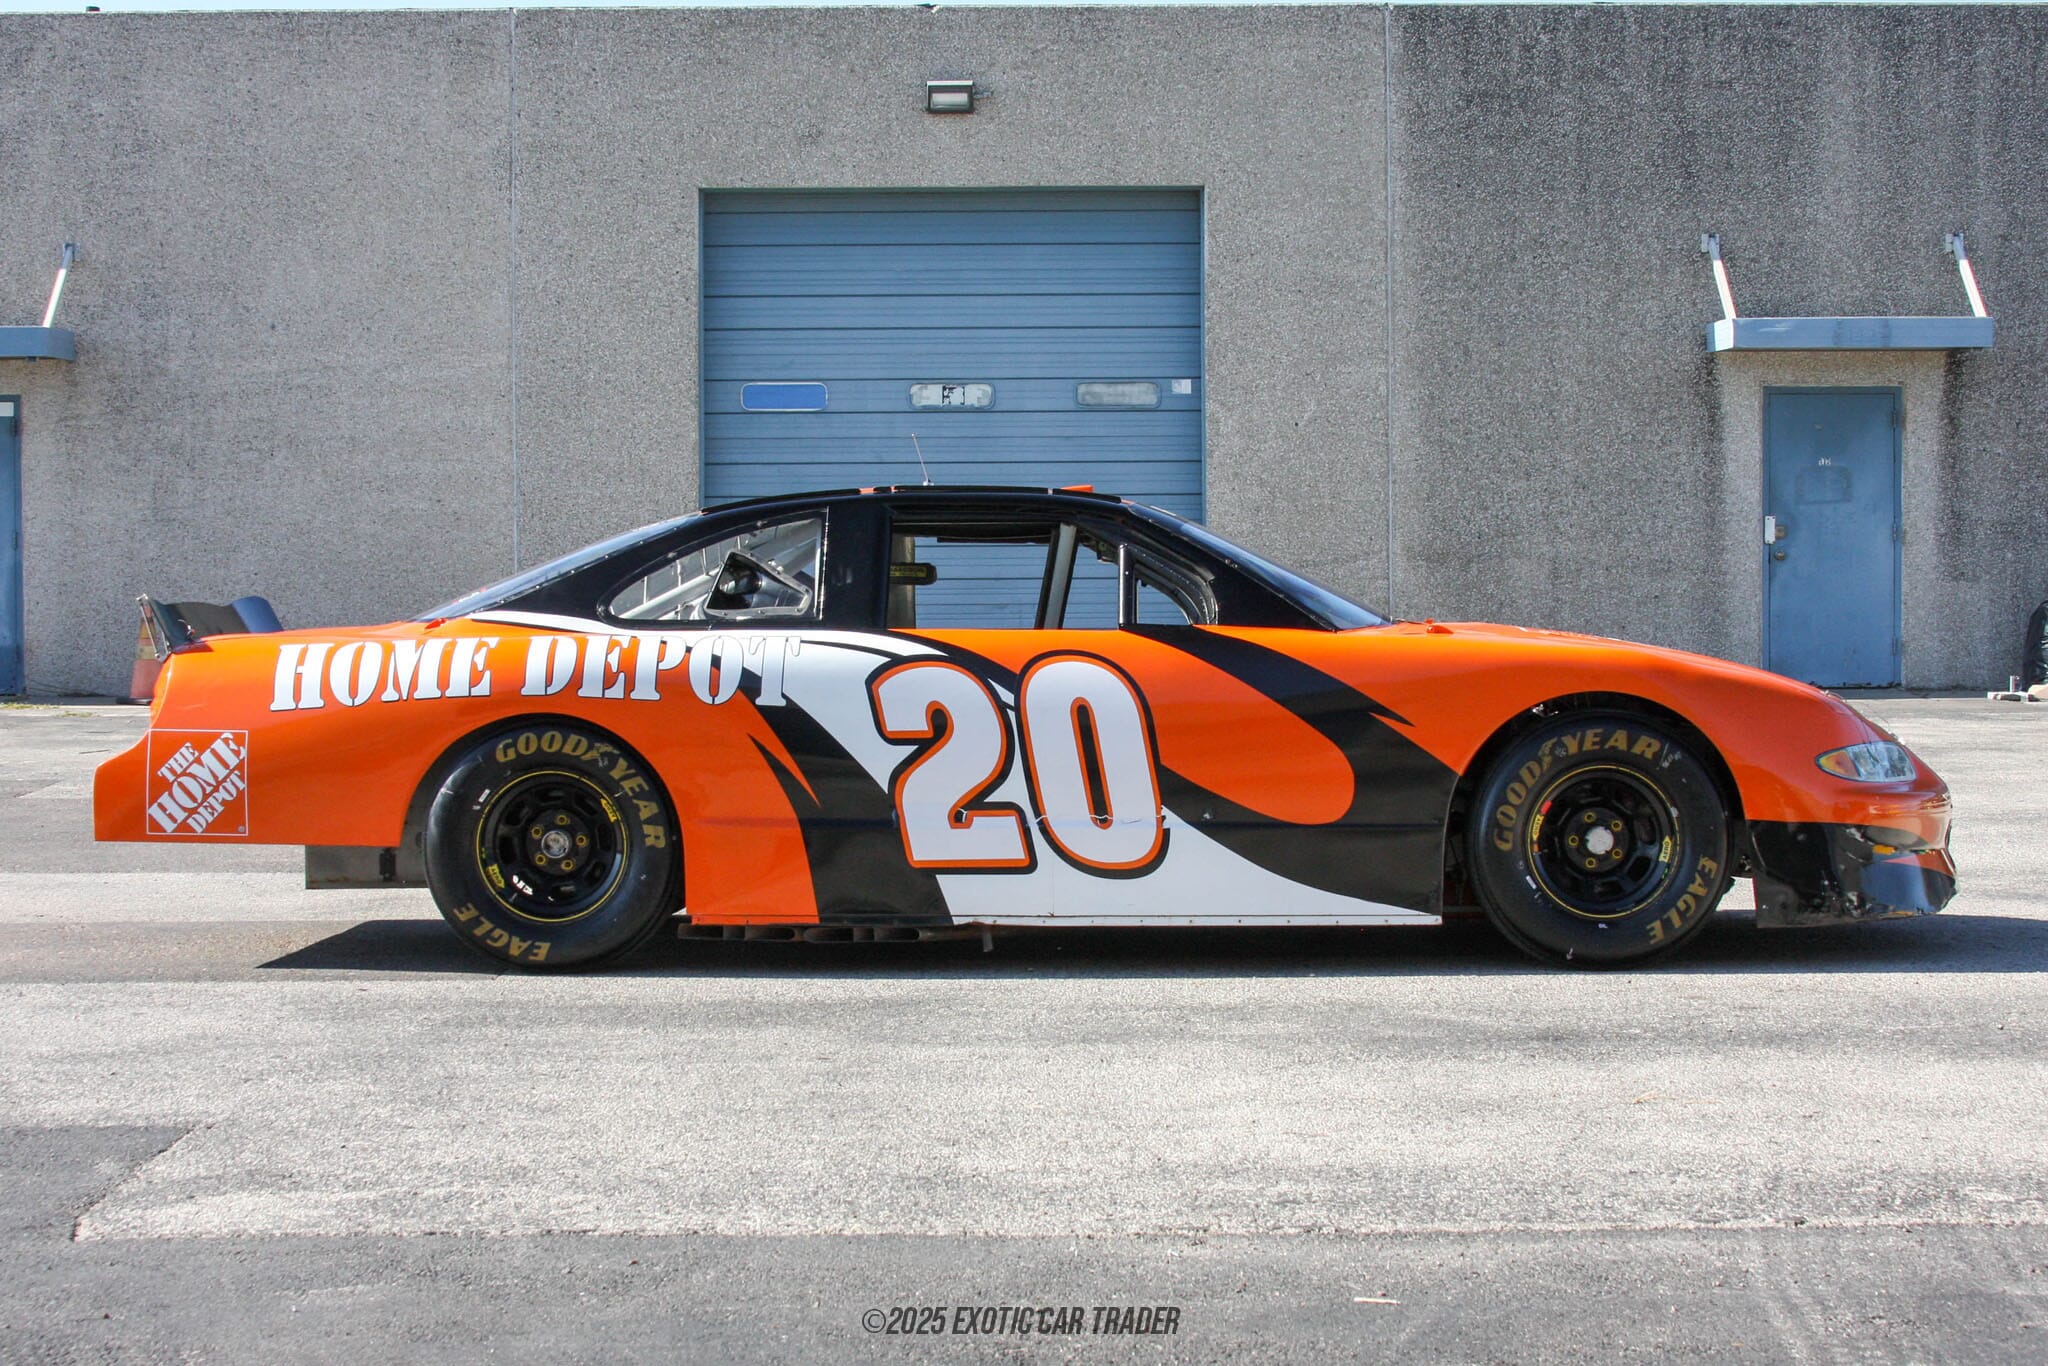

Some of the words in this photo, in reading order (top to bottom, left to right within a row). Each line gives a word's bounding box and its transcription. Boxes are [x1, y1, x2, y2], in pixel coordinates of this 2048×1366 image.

[269, 636, 500, 712] HOME
[520, 634, 801, 707] DEPOT
[148, 732, 246, 833] HOME
[157, 742, 200, 782] THE
[865, 649, 1170, 879] 20
[186, 770, 246, 834] DEPOT
[452, 902, 552, 962] EAGLE
[1645, 854, 1720, 945] EAGLE
